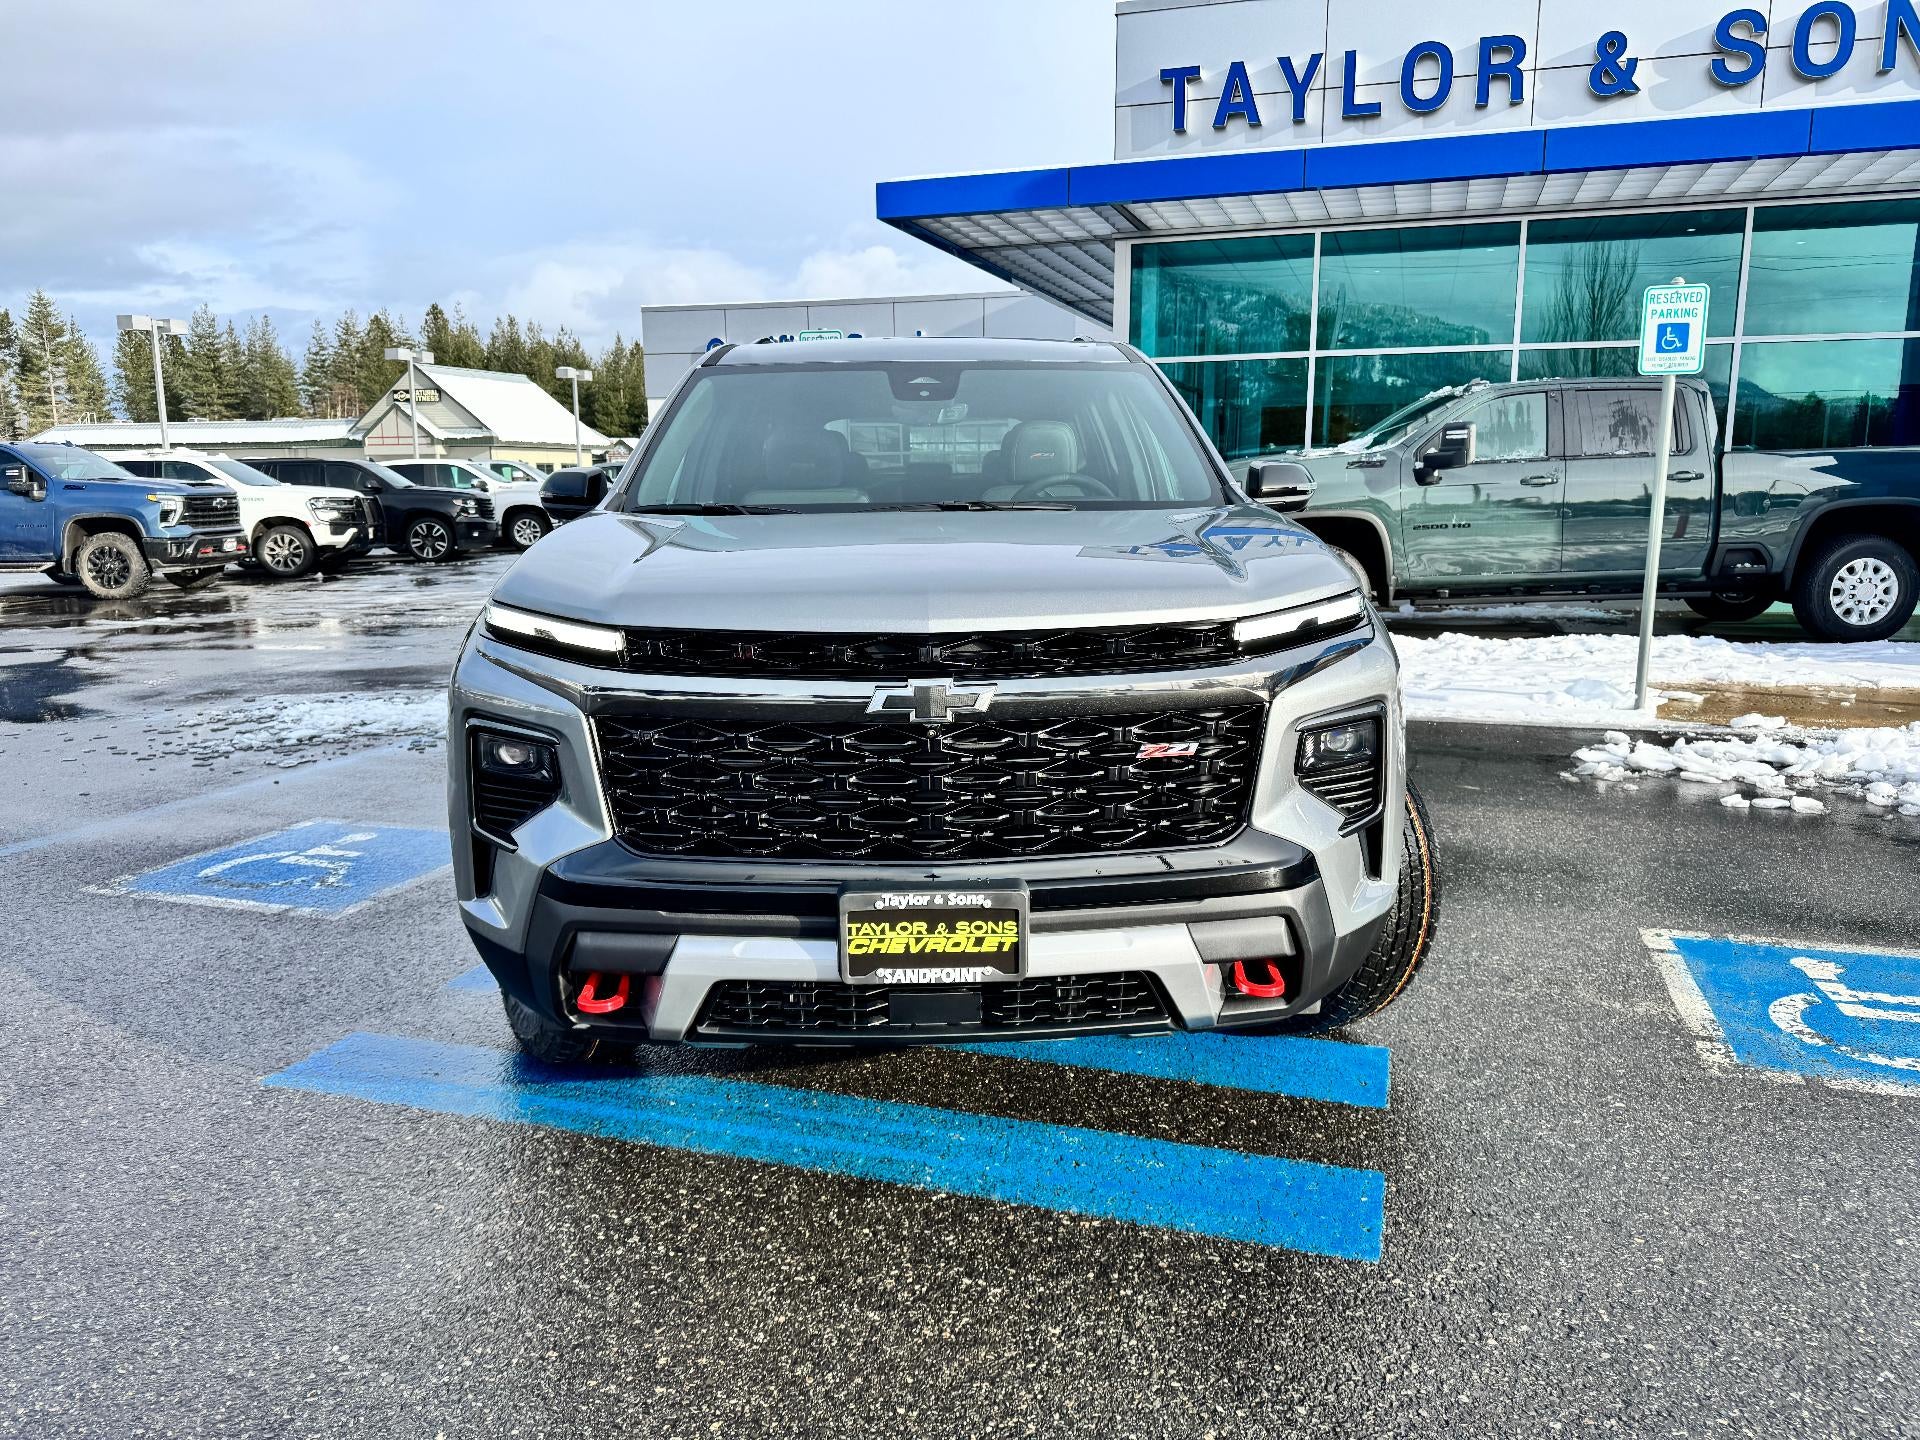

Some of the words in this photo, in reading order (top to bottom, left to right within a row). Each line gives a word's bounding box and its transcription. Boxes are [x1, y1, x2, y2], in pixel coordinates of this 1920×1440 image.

[1160, 34, 1526, 132] TAYLOR
[1588, 31, 1641, 98] &
[1649, 291, 1703, 304] RESERVED
[1650, 307, 1698, 319] PARKING
[1135, 742, 1200, 759] Z71
[881, 893, 931, 910] Taylor
[934, 894, 944, 905] &
[947, 892, 985, 906] Sons
[847, 921, 928, 936] TAYLOR
[934, 922, 949, 936] &
[955, 920, 1018, 935] SONS
[847, 936, 1019, 955] CHEVROLET
[883, 967, 982, 984] SANDPOINT
